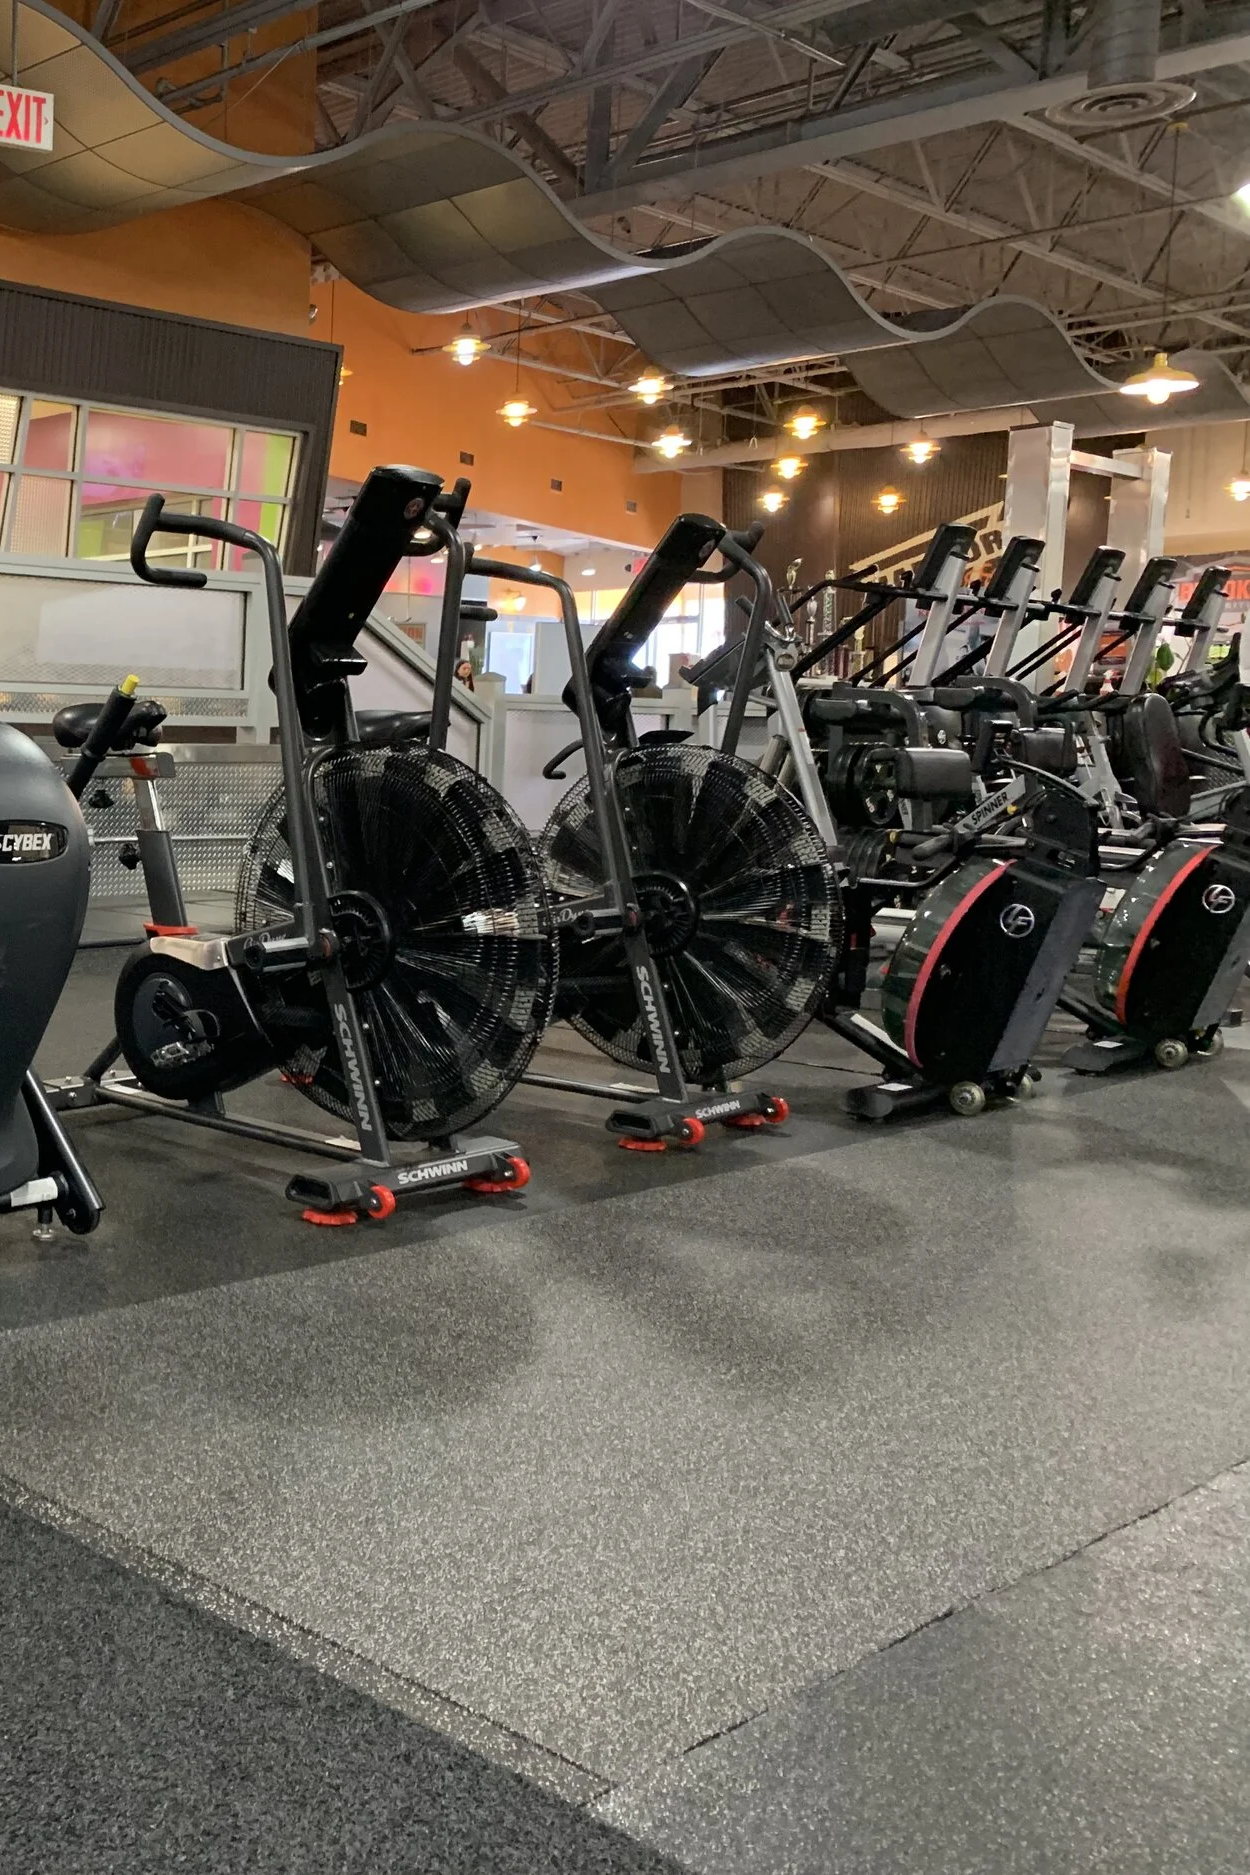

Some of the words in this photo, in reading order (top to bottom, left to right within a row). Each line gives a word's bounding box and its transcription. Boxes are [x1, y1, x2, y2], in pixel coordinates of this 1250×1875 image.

[971, 791, 1008, 826] SPINNER
[1, 833, 53, 852] CYBEX
[636, 965, 671, 1074] SCHWINN
[334, 1003, 372, 1132] SCHWINN
[695, 1100, 741, 1119] SCHWINN
[397, 1160, 468, 1185] SCHWINN
